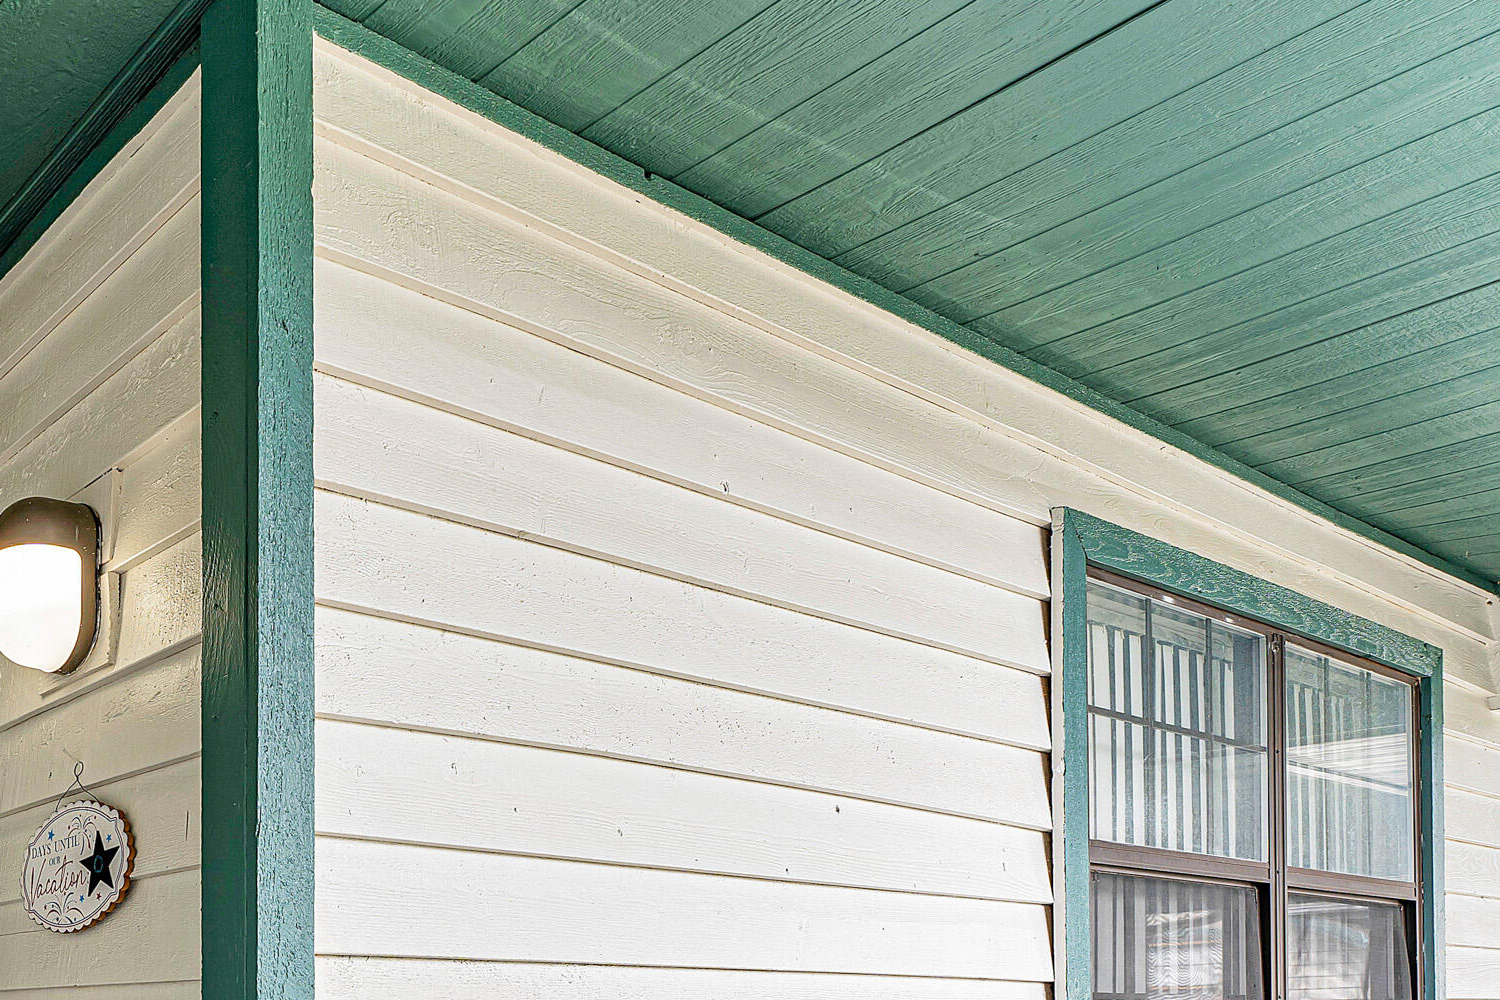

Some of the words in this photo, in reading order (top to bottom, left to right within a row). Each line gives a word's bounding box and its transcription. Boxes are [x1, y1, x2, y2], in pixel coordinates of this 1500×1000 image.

[31, 843, 51, 859] DAYS
[54, 835, 80, 853] UNTIL
[48, 856, 61, 866] OUR
